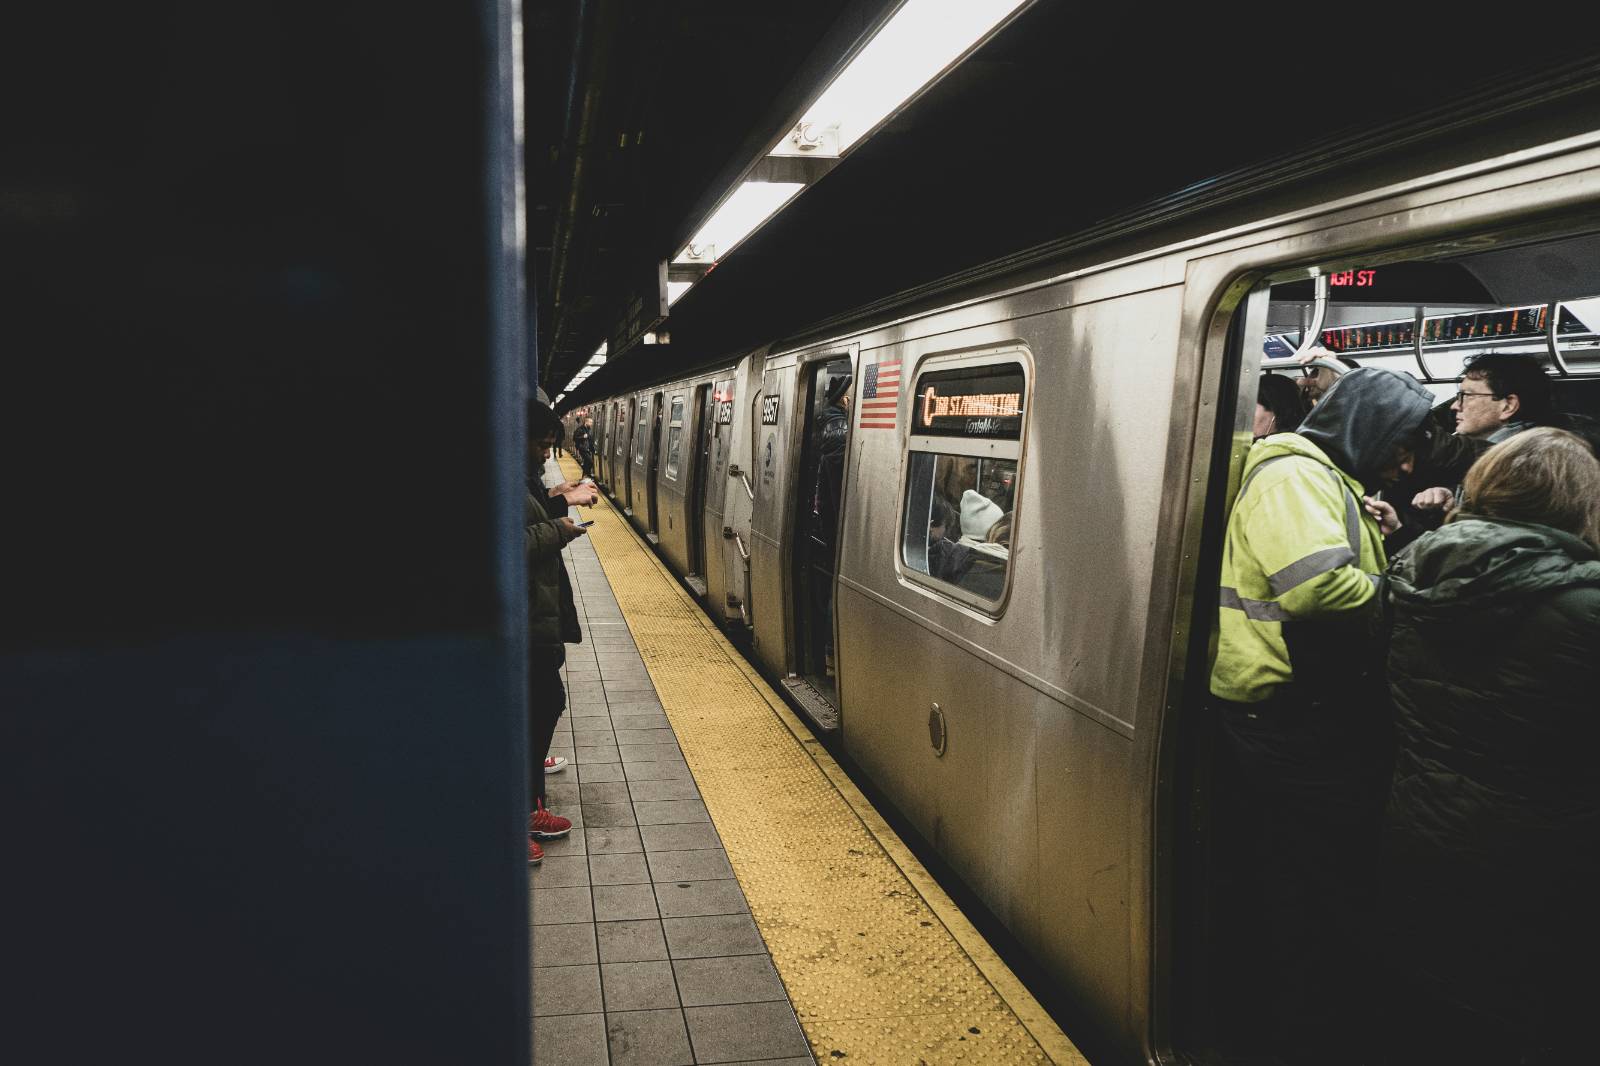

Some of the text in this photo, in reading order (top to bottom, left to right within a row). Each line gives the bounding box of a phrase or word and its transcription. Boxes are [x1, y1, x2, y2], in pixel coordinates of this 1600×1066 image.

[1330, 270, 1376, 286] IGH ST
[923, 386, 935, 427] C
